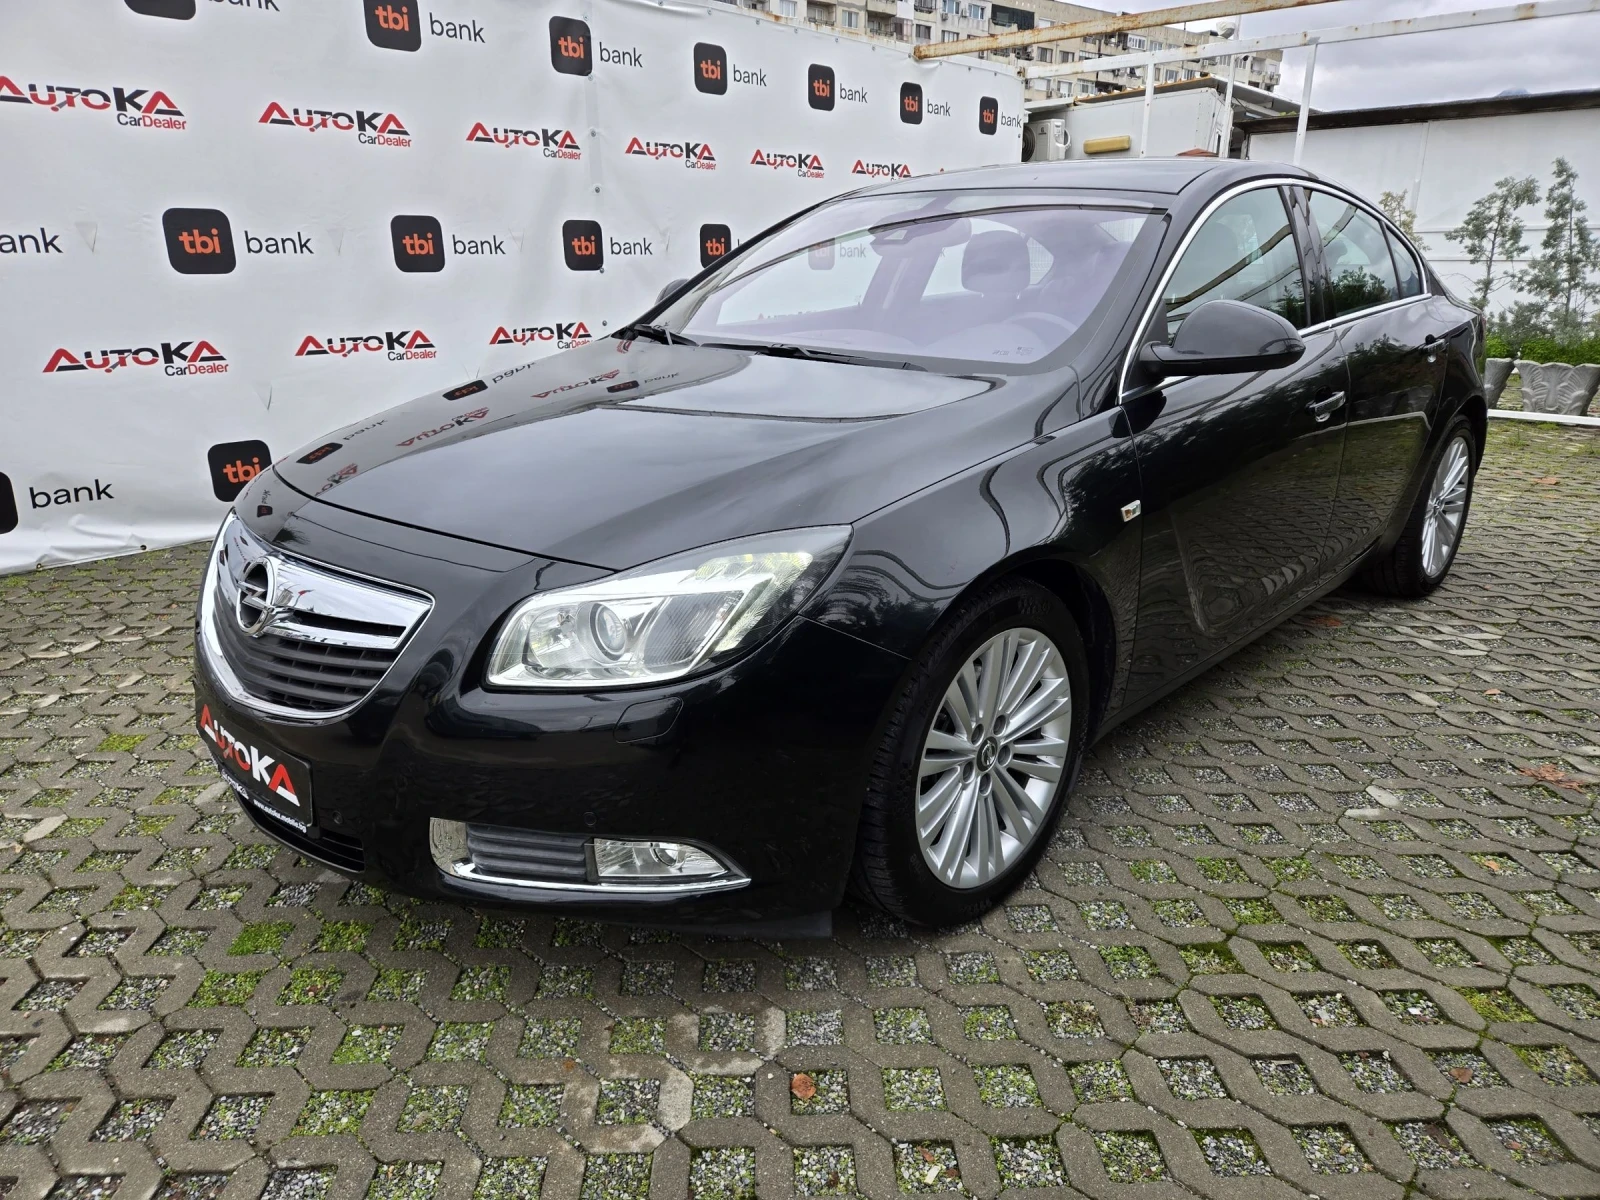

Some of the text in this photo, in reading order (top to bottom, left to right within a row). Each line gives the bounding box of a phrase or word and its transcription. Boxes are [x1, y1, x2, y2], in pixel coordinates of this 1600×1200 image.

[374, 5, 486, 44] tbi bank
[558, 36, 643, 69] tbi bank
[700, 60, 768, 88] tbi bank
[0, 76, 185, 117] AUTOKA
[813, 78, 868, 104] tbi bank
[259, 101, 411, 136] AUTOKA
[904, 96, 951, 117] tbi bank
[117, 113, 187, 130] CarDealer
[983, 109, 1022, 129] tbi bank
[358, 133, 412, 148] CarDealer
[466, 122, 581, 150] AUTOKA
[543, 148, 582, 160] CarDealer
[625, 137, 716, 161] AUTOKA
[750, 149, 825, 171] AUTOKA
[685, 159, 717, 171] CarDealer
[797, 169, 825, 179] CarDealer
[0, 226, 64, 254] ank
[178, 227, 315, 255] tbi bank
[402, 232, 507, 255] tbi bank
[571, 236, 653, 256] tbi bank
[705, 238, 726, 256] tbi
[839, 242, 867, 258] bank
[295, 329, 437, 357] AUTOKA
[489, 321, 593, 345] AUTOKA
[43, 340, 227, 373] AUTOKA
[387, 349, 437, 361] CarDealer
[164, 361, 229, 377] CarDealer
[223, 456, 261, 483] tbi
[28, 478, 115, 510] bank
[200, 704, 301, 807] AUTOKA
